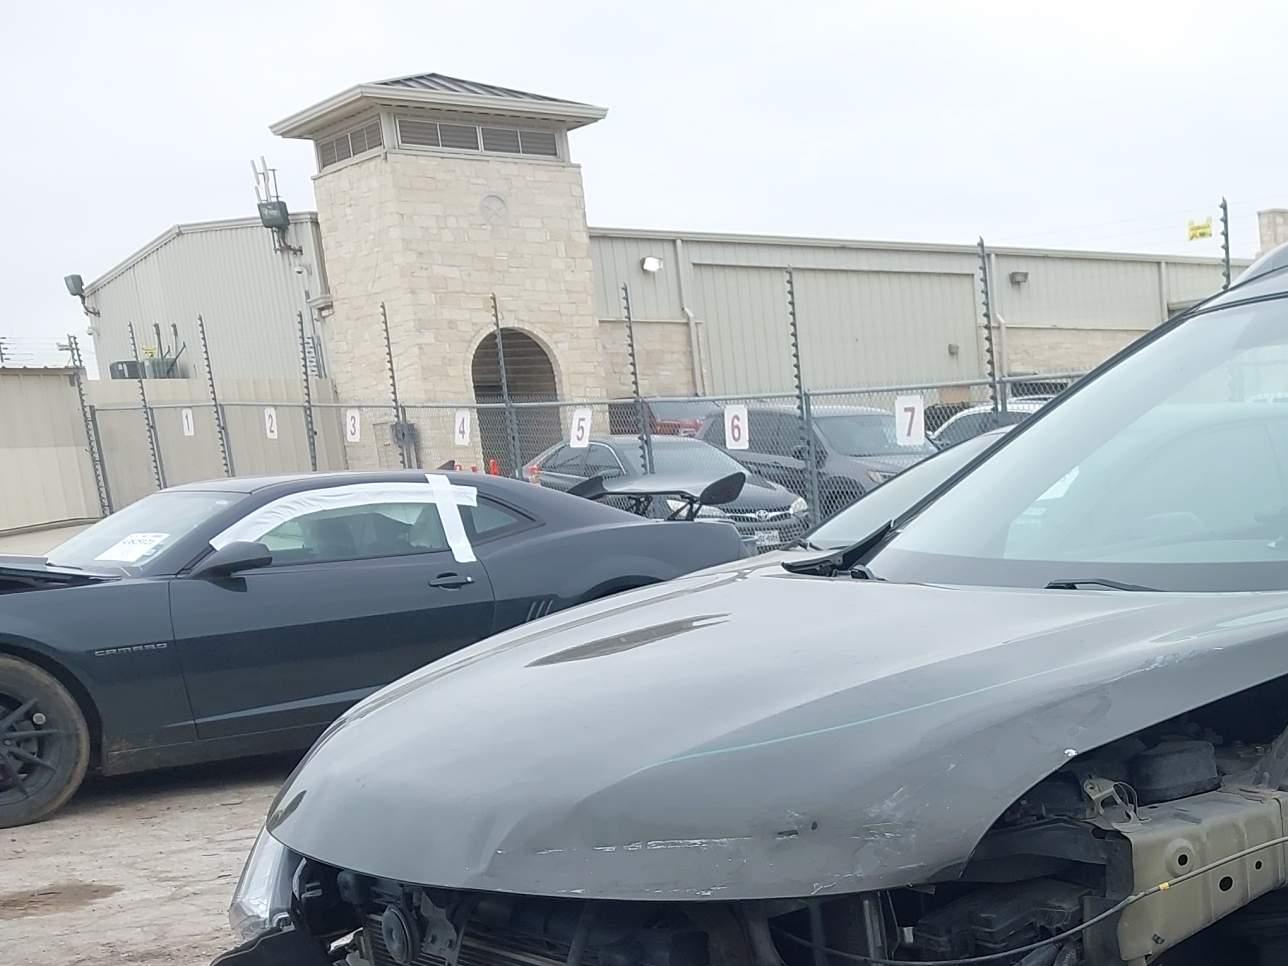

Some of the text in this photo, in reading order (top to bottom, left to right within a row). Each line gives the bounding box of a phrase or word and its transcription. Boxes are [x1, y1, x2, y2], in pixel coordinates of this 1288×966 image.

[268, 413, 275, 434] 2
[350, 415, 357, 436] 3
[458, 417, 466, 439] 4
[576, 417, 586, 441] 5
[730, 414, 742, 442] 6
[903, 406, 915, 437] 7
